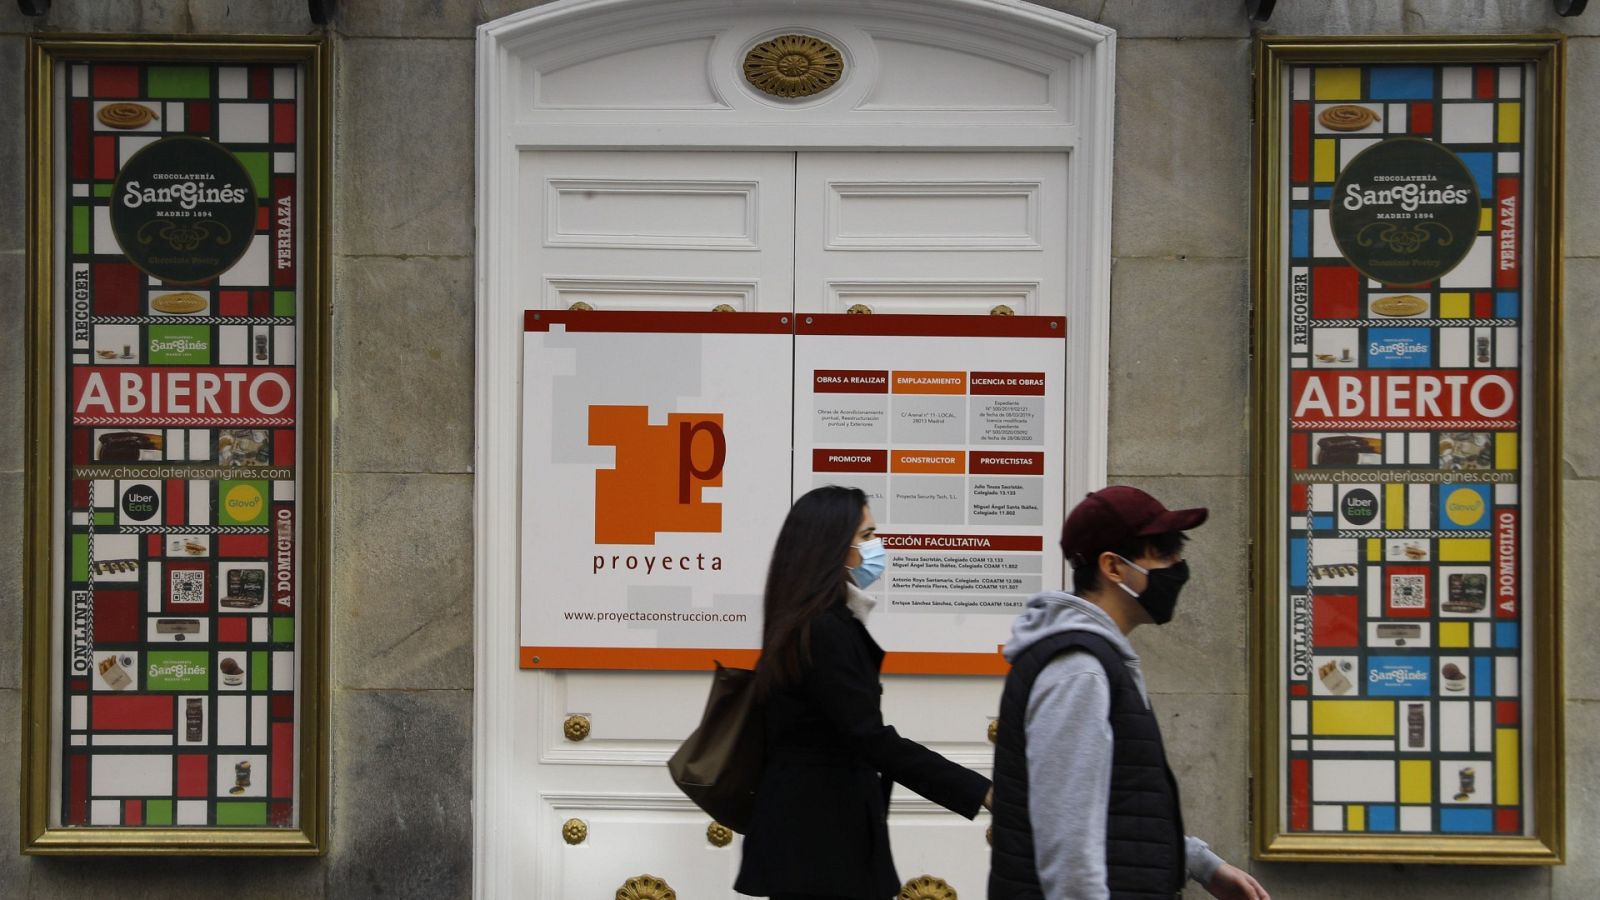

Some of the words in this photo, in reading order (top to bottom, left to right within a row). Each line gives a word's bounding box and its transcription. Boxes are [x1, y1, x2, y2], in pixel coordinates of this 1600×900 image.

[153, 172, 216, 180] CHOCOLATERÍA
[1373, 174, 1438, 182] CHOCOLATERÍA
[278, 195, 292, 269] TERRAZA
[1501, 196, 1516, 271] TERRAZA
[75, 269, 90, 342] RECOGER
[1294, 273, 1308, 346] RECOGER
[897, 377, 962, 385] EMPLAZAMIENTO
[76, 371, 292, 415] ABIERTO
[1294, 374, 1514, 418] ABIERTO
[678, 420, 727, 505] p
[900, 456, 956, 464] CONSTRUCTOR
[76, 466, 292, 481] www.chocolateriasangines.com
[1294, 470, 1514, 484] www.chocolateriasangines.com
[128, 494, 153, 503] Uber
[1347, 498, 1372, 507] Uber
[128, 504, 153, 512] Eats
[1347, 507, 1372, 516] Eats
[924, 537, 991, 547] FACULTATIVA
[1500, 513, 1515, 598] DOMICILIO
[593, 552, 723, 575] proyecta
[278, 595, 292, 608] A
[1500, 600, 1514, 613] A
[563, 608, 748, 624] www.proyectaconstruccion.com
[74, 592, 88, 672] ONLINE
[1294, 596, 1308, 677] ONLINE
